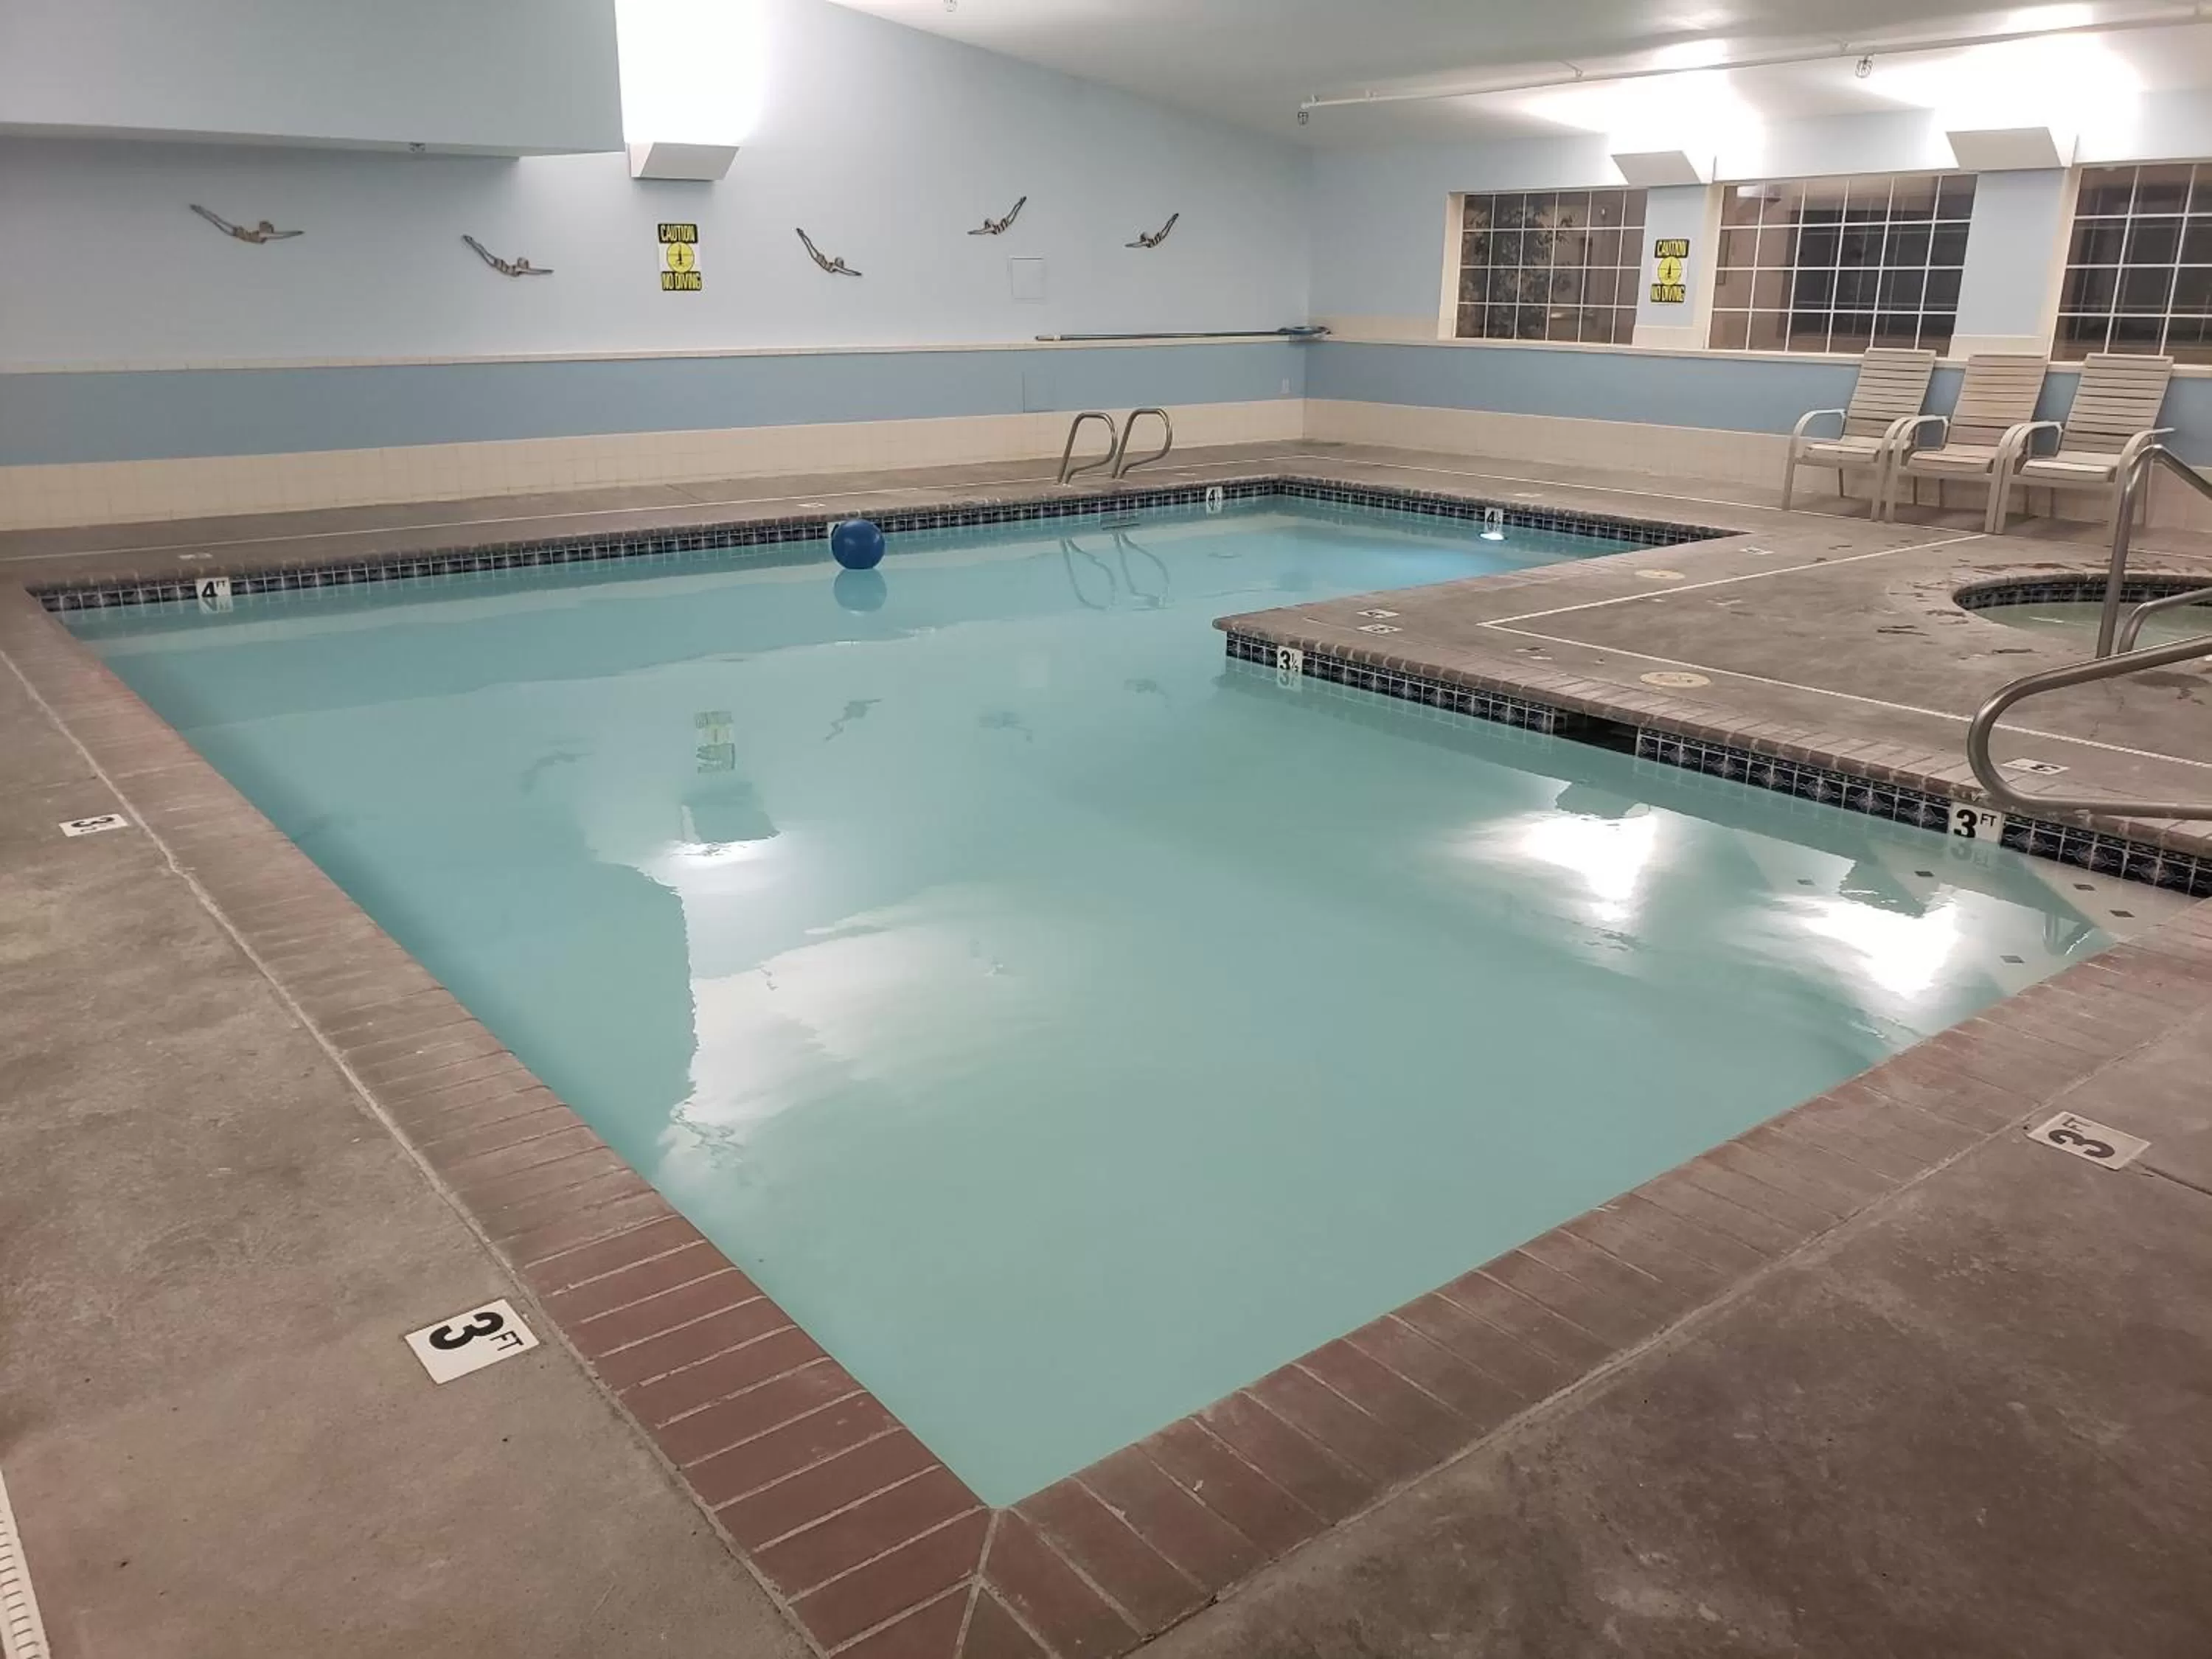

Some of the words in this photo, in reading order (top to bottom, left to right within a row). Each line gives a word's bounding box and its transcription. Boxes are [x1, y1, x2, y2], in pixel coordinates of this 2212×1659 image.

[660, 225, 695, 242] CAUTION
[663, 272, 674, 290] NO
[675, 272, 700, 290] DIVING
[201, 581, 218, 598] 4
[1953, 809, 1978, 838] 3
[1980, 813, 1997, 827] FT
[2062, 1113, 2092, 1133] FT
[2048, 1129, 2115, 1158] 3
[429, 1312, 504, 1350] 3
[490, 1331, 524, 1351] FT
